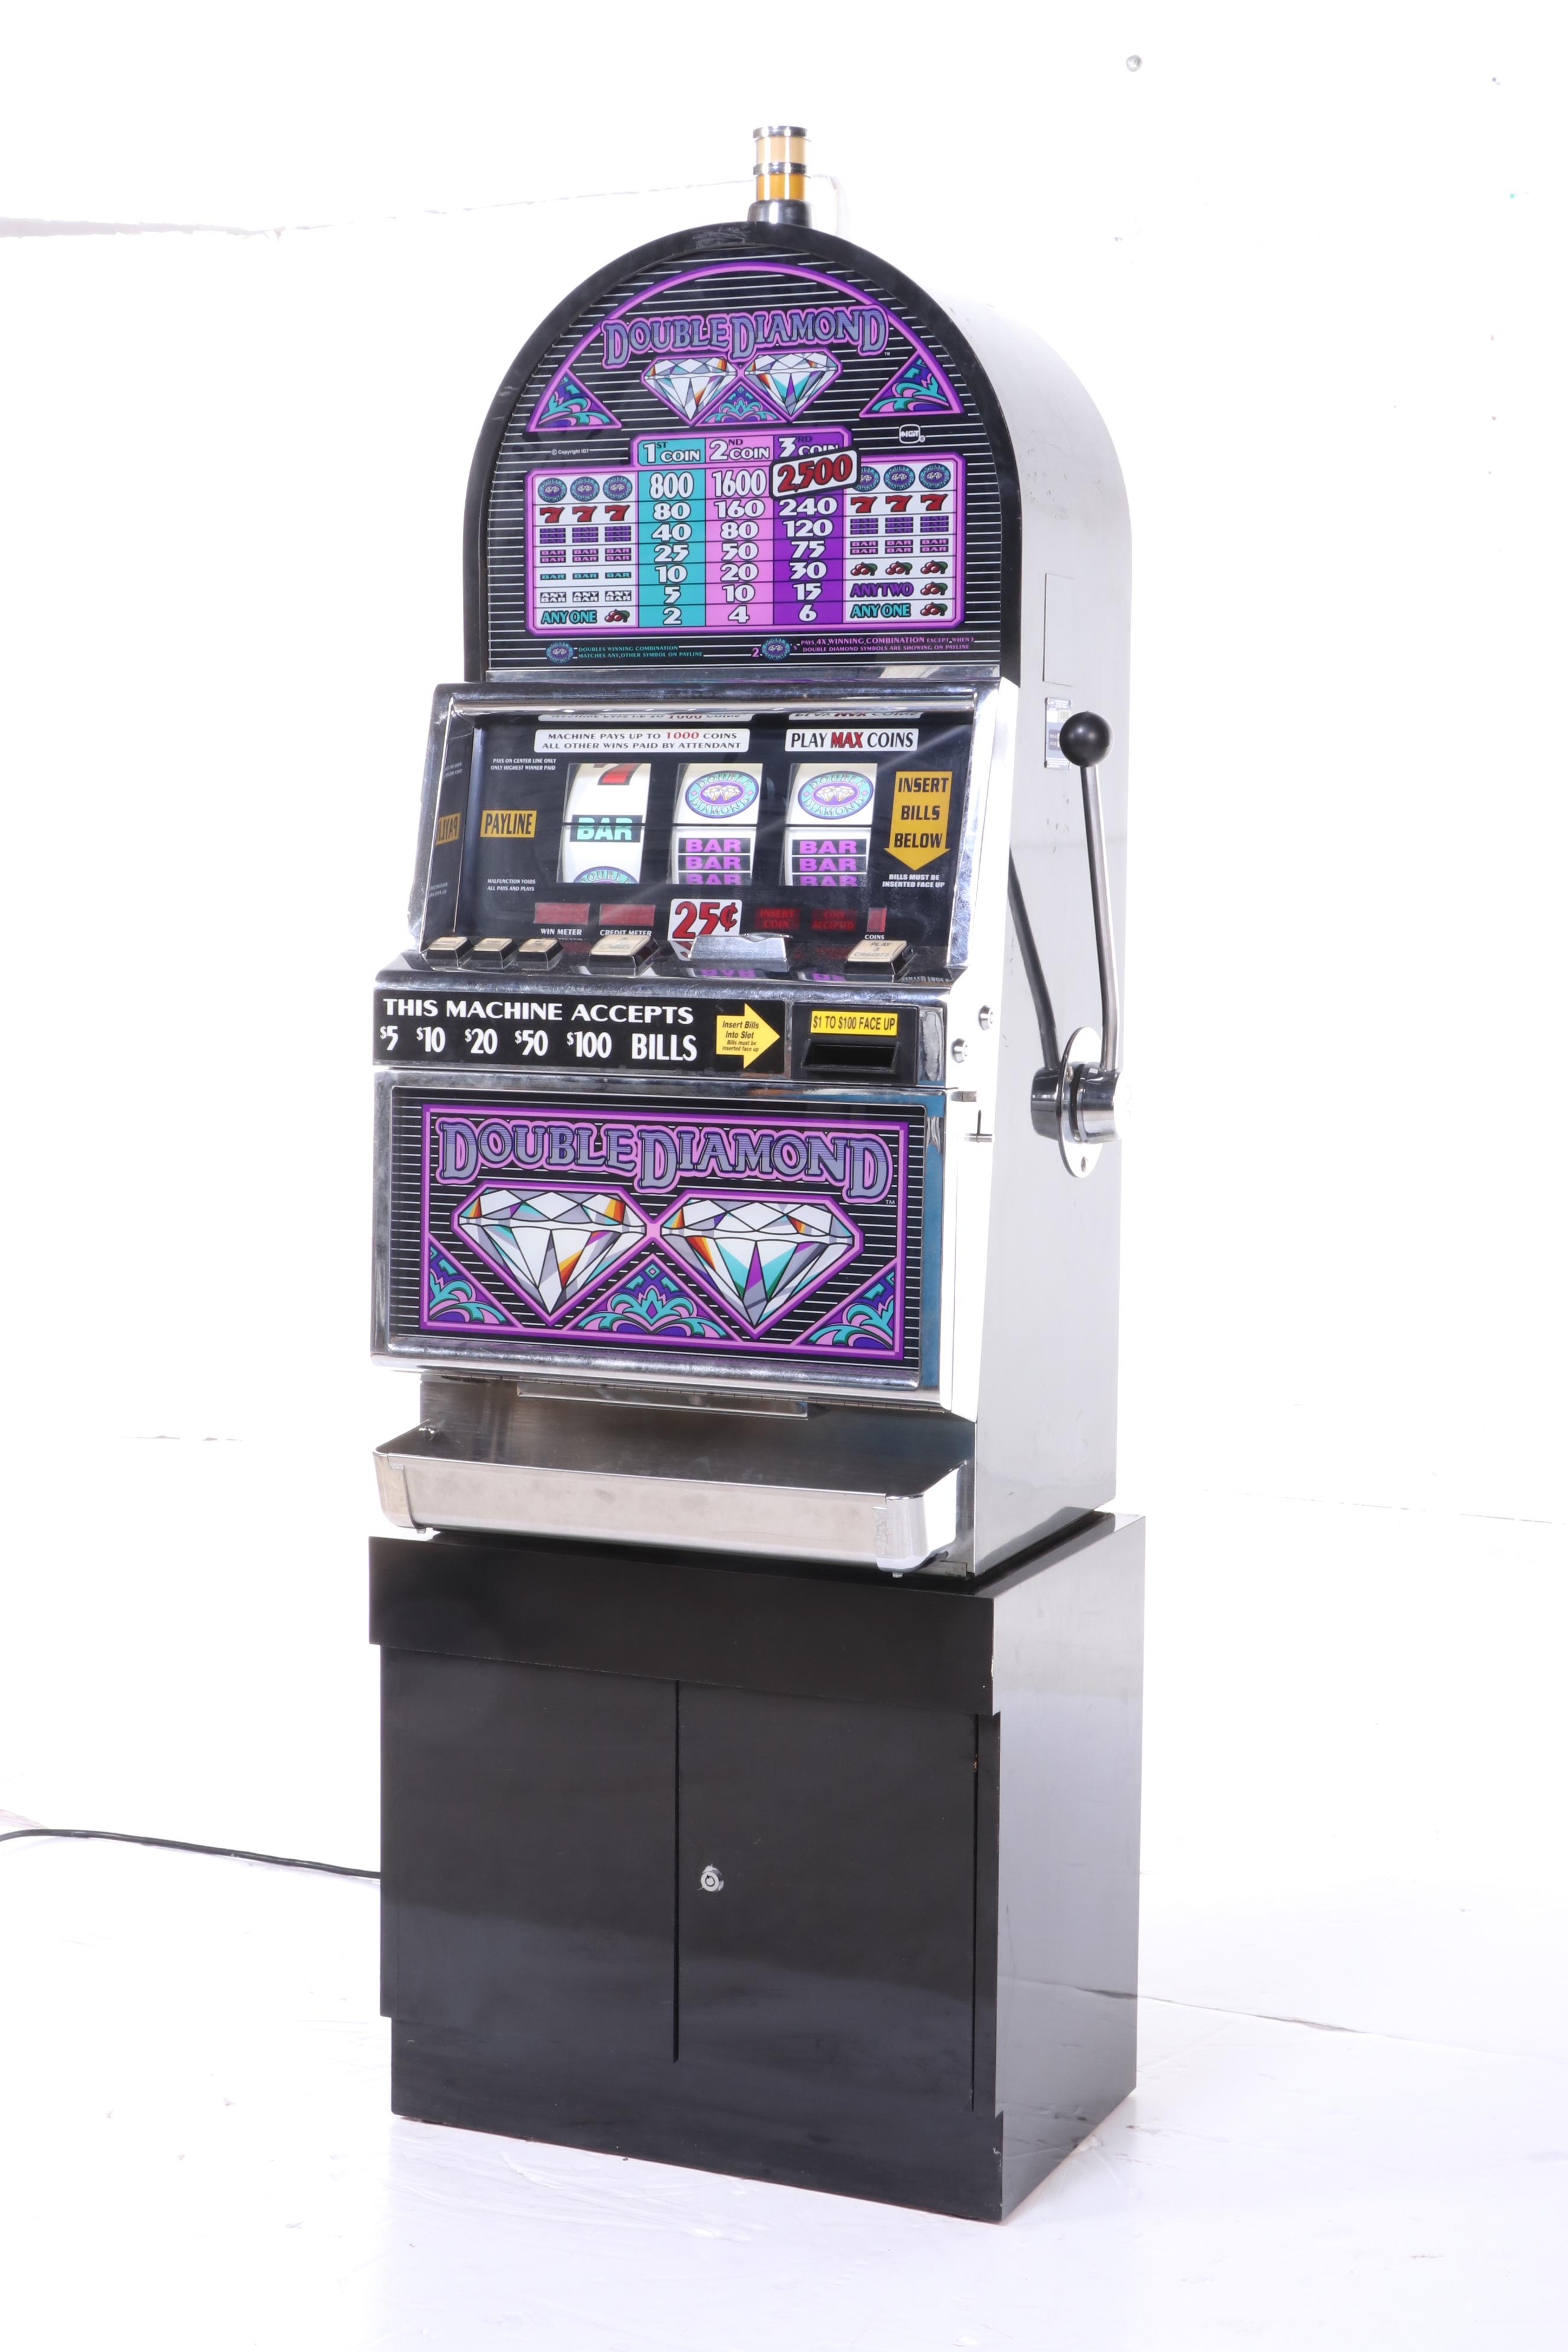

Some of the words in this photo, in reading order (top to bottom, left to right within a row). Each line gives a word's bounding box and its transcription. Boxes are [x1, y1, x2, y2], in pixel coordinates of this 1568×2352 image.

[603, 315, 729, 366] DOUBLE
[730, 307, 887, 359] DIAMOND
[660, 449, 701, 462] COIN
[728, 447, 770, 460] COIN
[649, 472, 694, 499] 800
[712, 469, 767, 497] 1600
[653, 502, 691, 520] 80
[714, 499, 765, 519] 160
[779, 496, 837, 516] 240
[652, 522, 692, 541] 40
[720, 521, 759, 540] 80
[782, 518, 834, 538] 120
[654, 543, 690, 562] 25
[721, 541, 759, 561] 50
[790, 540, 826, 558] 75
[655, 564, 687, 583] 10
[720, 563, 759, 582] 20
[789, 561, 827, 580] 30
[664, 586, 681, 604] 5
[723, 583, 755, 603] 10
[793, 582, 822, 601] 15
[850, 583, 880, 597] ANY
[878, 582, 914, 597] TWO
[541, 610, 569, 624] ANY
[569, 610, 597, 624] ONE
[663, 606, 682, 625] 2
[728, 605, 749, 623] 4
[799, 604, 818, 622] 6
[850, 604, 880, 618] ANY
[881, 603, 911, 618] ONE
[752, 647, 759, 657] 2
[666, 731, 700, 740] 1000
[791, 733, 828, 748] PLAY
[831, 731, 864, 749] MAX
[867, 732, 914, 748] COINS
[898, 778, 949, 792] INSERT
[900, 805, 940, 820] BILLS
[484, 813, 533, 835] PAYLINE
[577, 817, 633, 840] BAR
[685, 839, 741, 852] BAR
[799, 840, 857, 854] BAR
[894, 833, 943, 848] BELOW
[685, 856, 741, 870] BAR
[799, 858, 857, 871] BAR
[383, 998, 439, 1017] THIS
[446, 1000, 562, 1020] MACHINE
[571, 1004, 694, 1024] ACCEPTS
[722, 1020, 743, 1028] Insert
[813, 1015, 822, 1028] $1
[825, 1015, 836, 1028] TO
[838, 1016, 856, 1030] $100
[859, 1017, 881, 1030] FACE
[884, 1018, 895, 1030] UP
[380, 1025, 398, 1051] $5
[416, 1026, 446, 1053] $10
[465, 1028, 498, 1054] $20
[515, 1030, 548, 1056] $50
[567, 1031, 612, 1058] $100
[632, 1033, 697, 1061] BILLS
[442, 1122, 636, 1178] DOUBLE
[638, 1128, 888, 1198] DIAMOND
